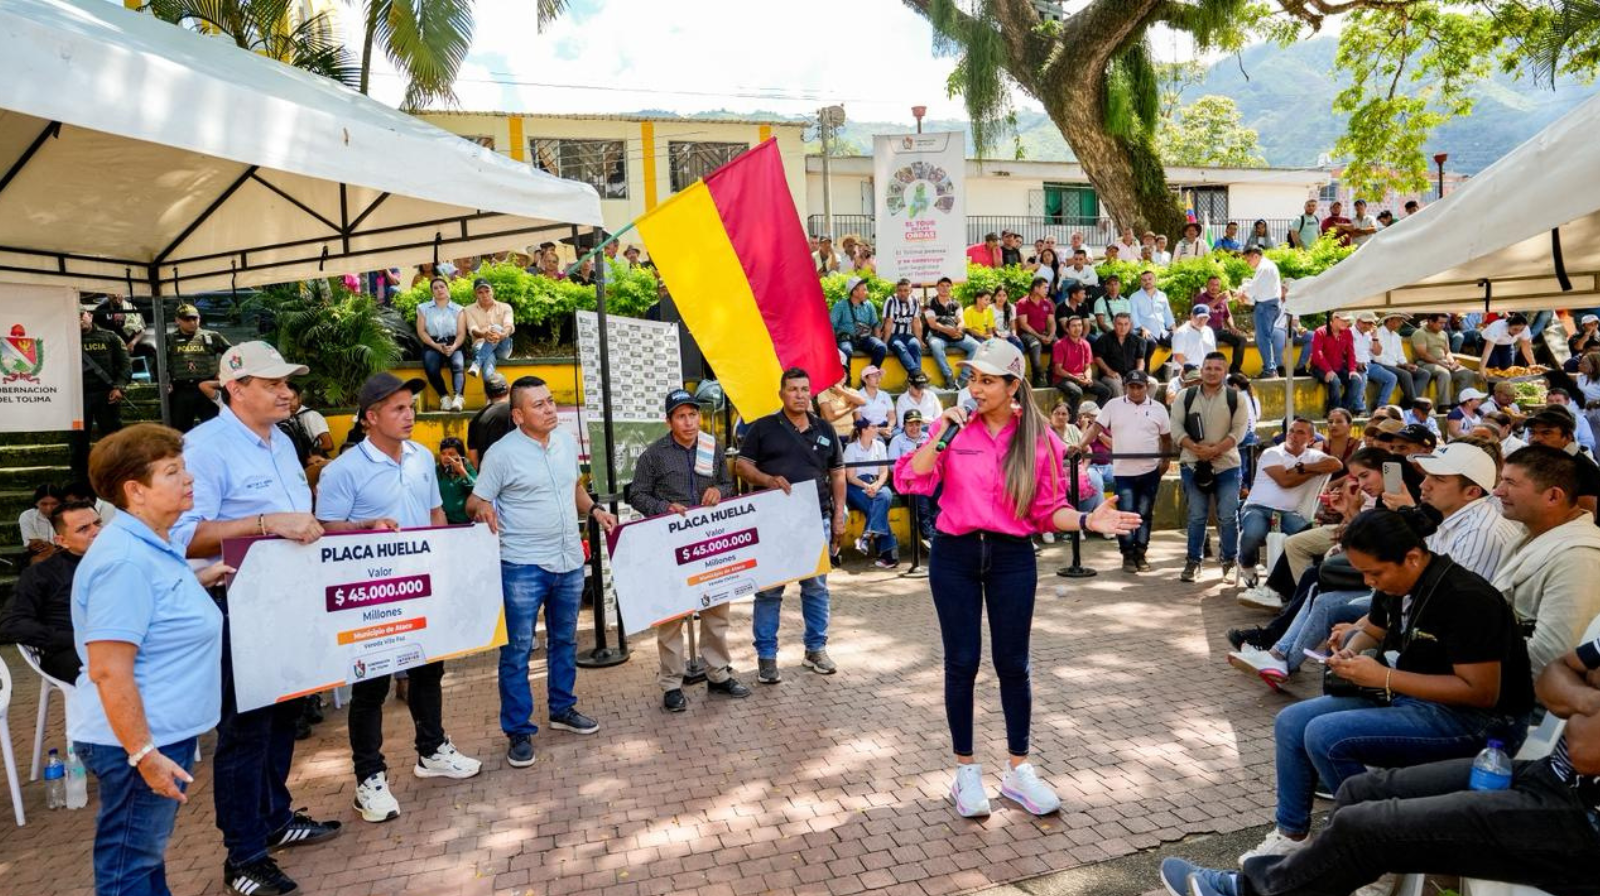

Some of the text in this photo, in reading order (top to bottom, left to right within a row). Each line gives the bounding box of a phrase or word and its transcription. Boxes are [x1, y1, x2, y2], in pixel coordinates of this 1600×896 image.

[15, 395, 53, 404] TOLIMA
[668, 503, 756, 533] PLACA HUELLA
[705, 527, 725, 538] Valor
[321, 540, 431, 563] PLACA HUELLA
[682, 532, 752, 560] $ 45.000.000
[705, 555, 737, 569] Millones
[367, 566, 393, 578] Valor
[335, 579, 424, 606] $ 45.000.000
[363, 607, 402, 621] Millones
